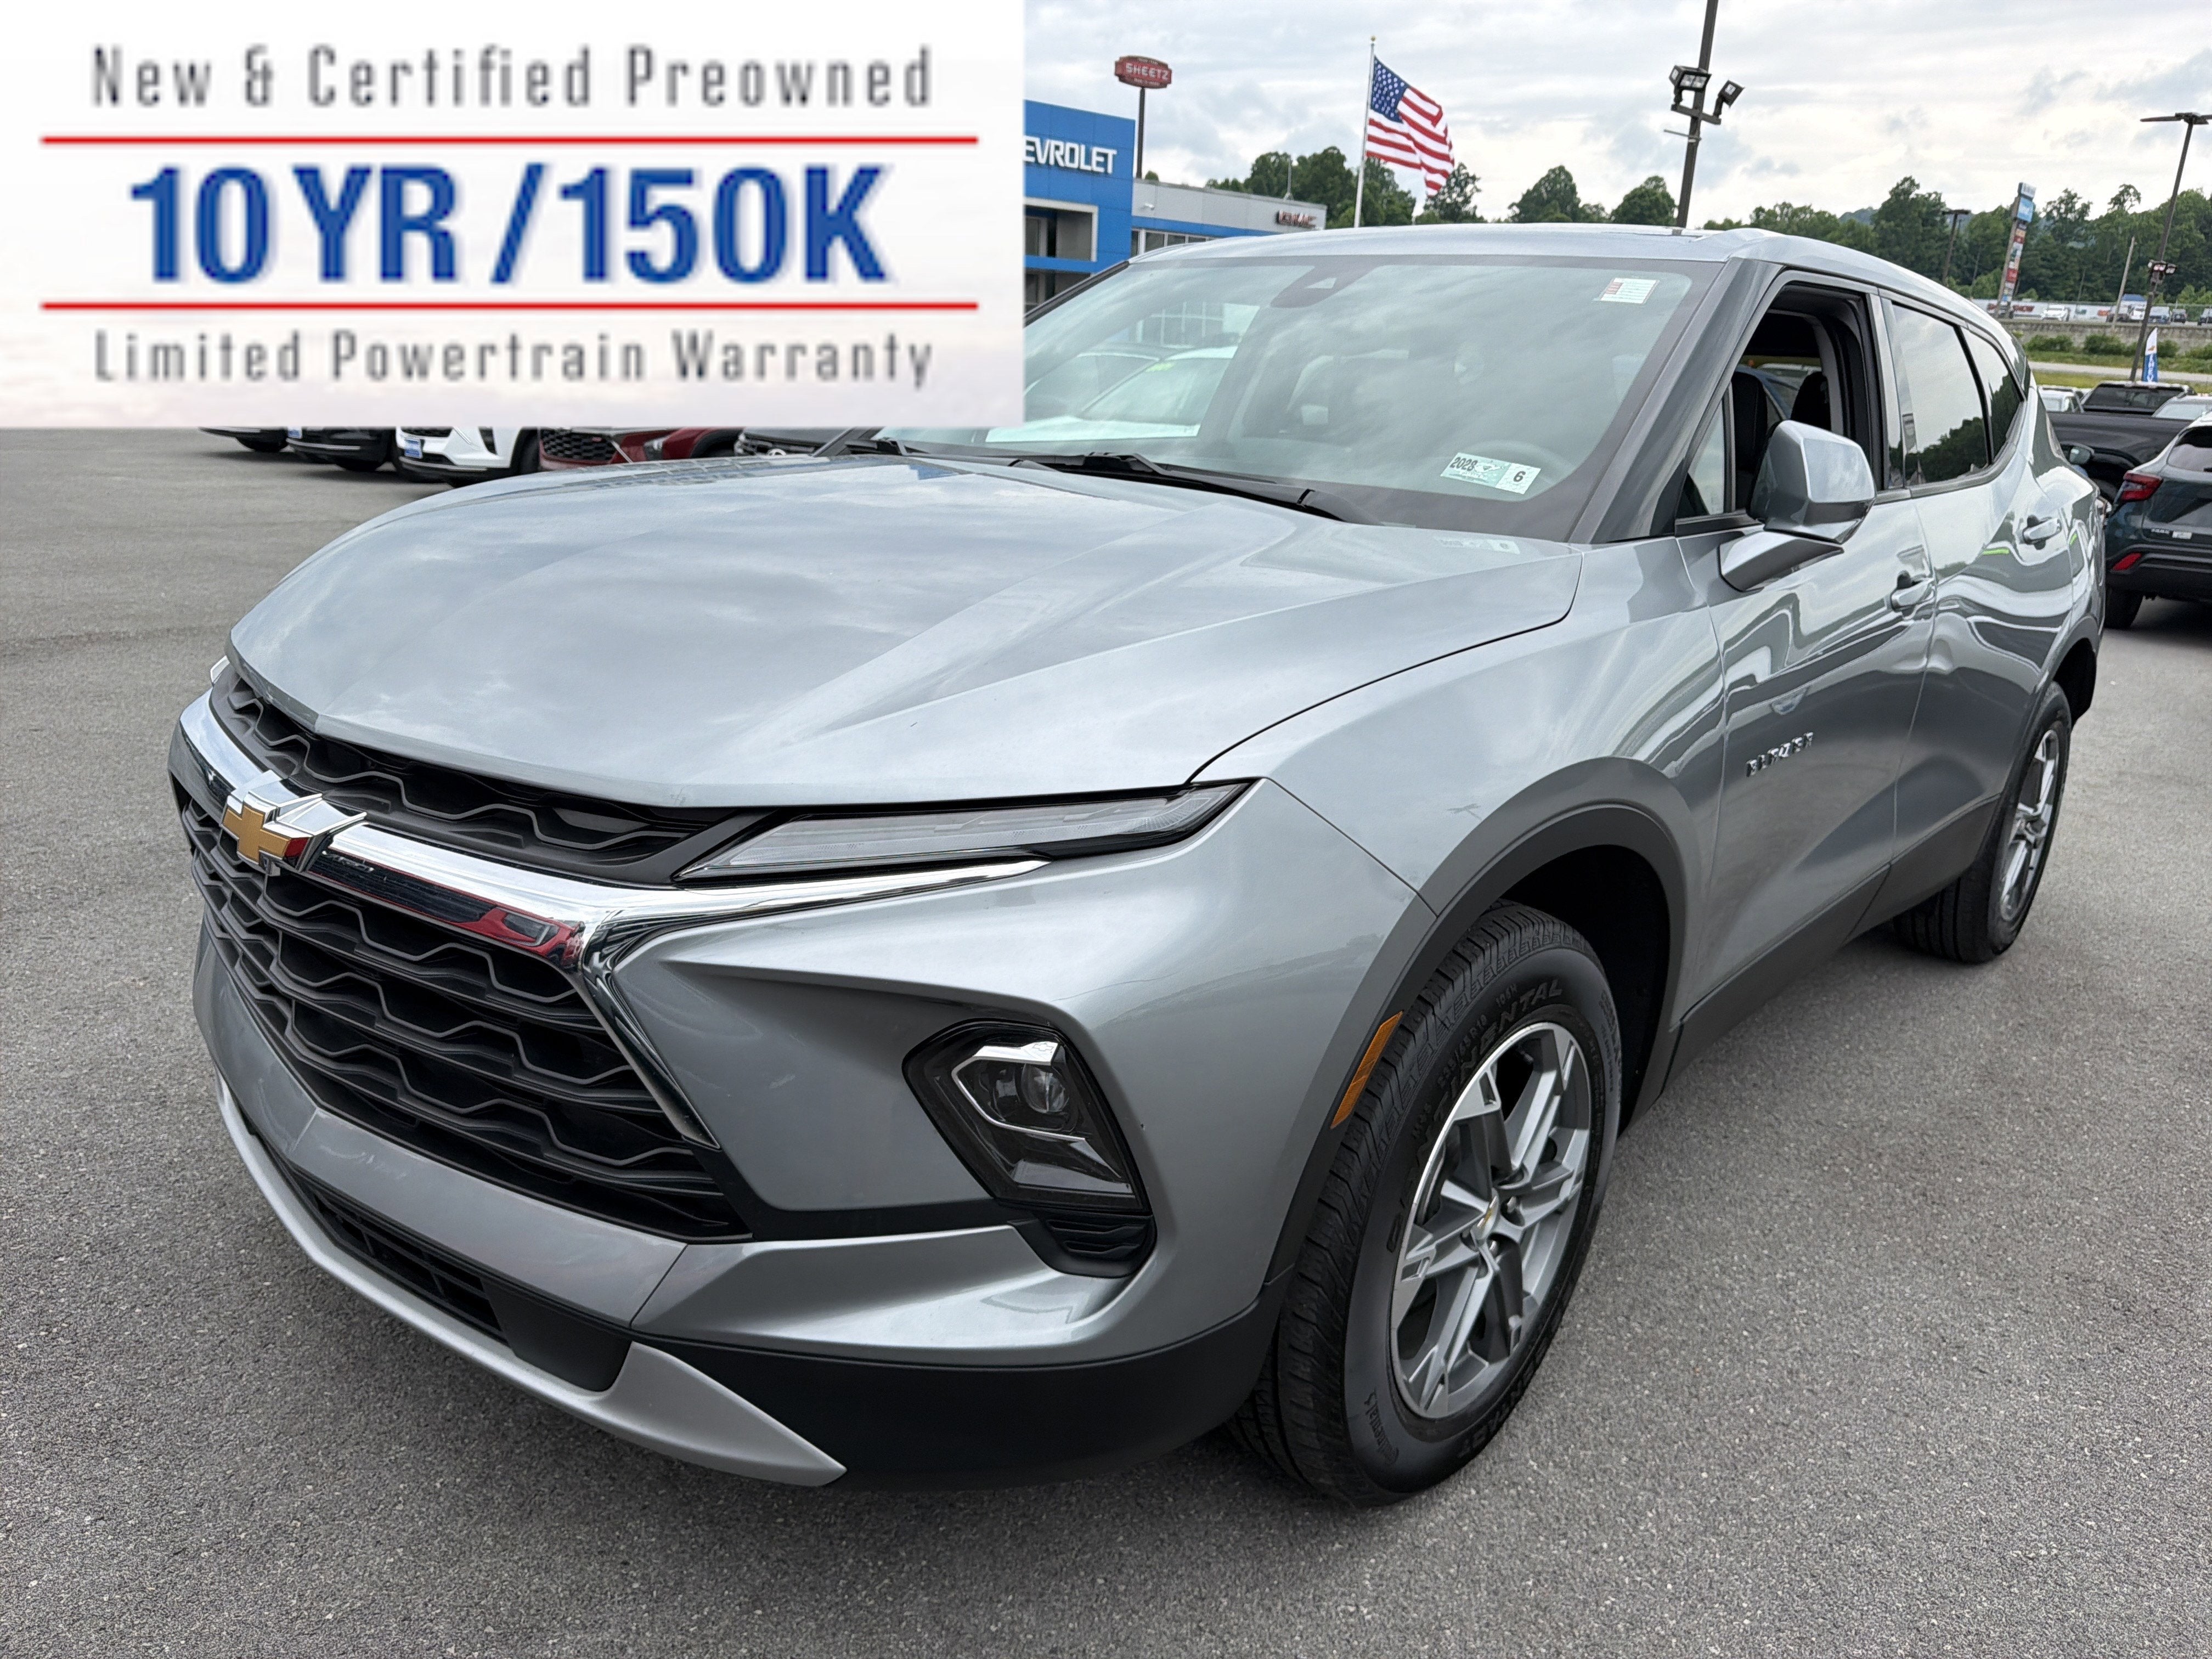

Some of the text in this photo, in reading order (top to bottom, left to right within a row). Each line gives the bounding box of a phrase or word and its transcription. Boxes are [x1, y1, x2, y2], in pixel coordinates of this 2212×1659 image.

[1126, 63, 1170, 80] SHEETZ
[1450, 456, 1479, 472] 2028
[1513, 471, 1526, 482] 6
